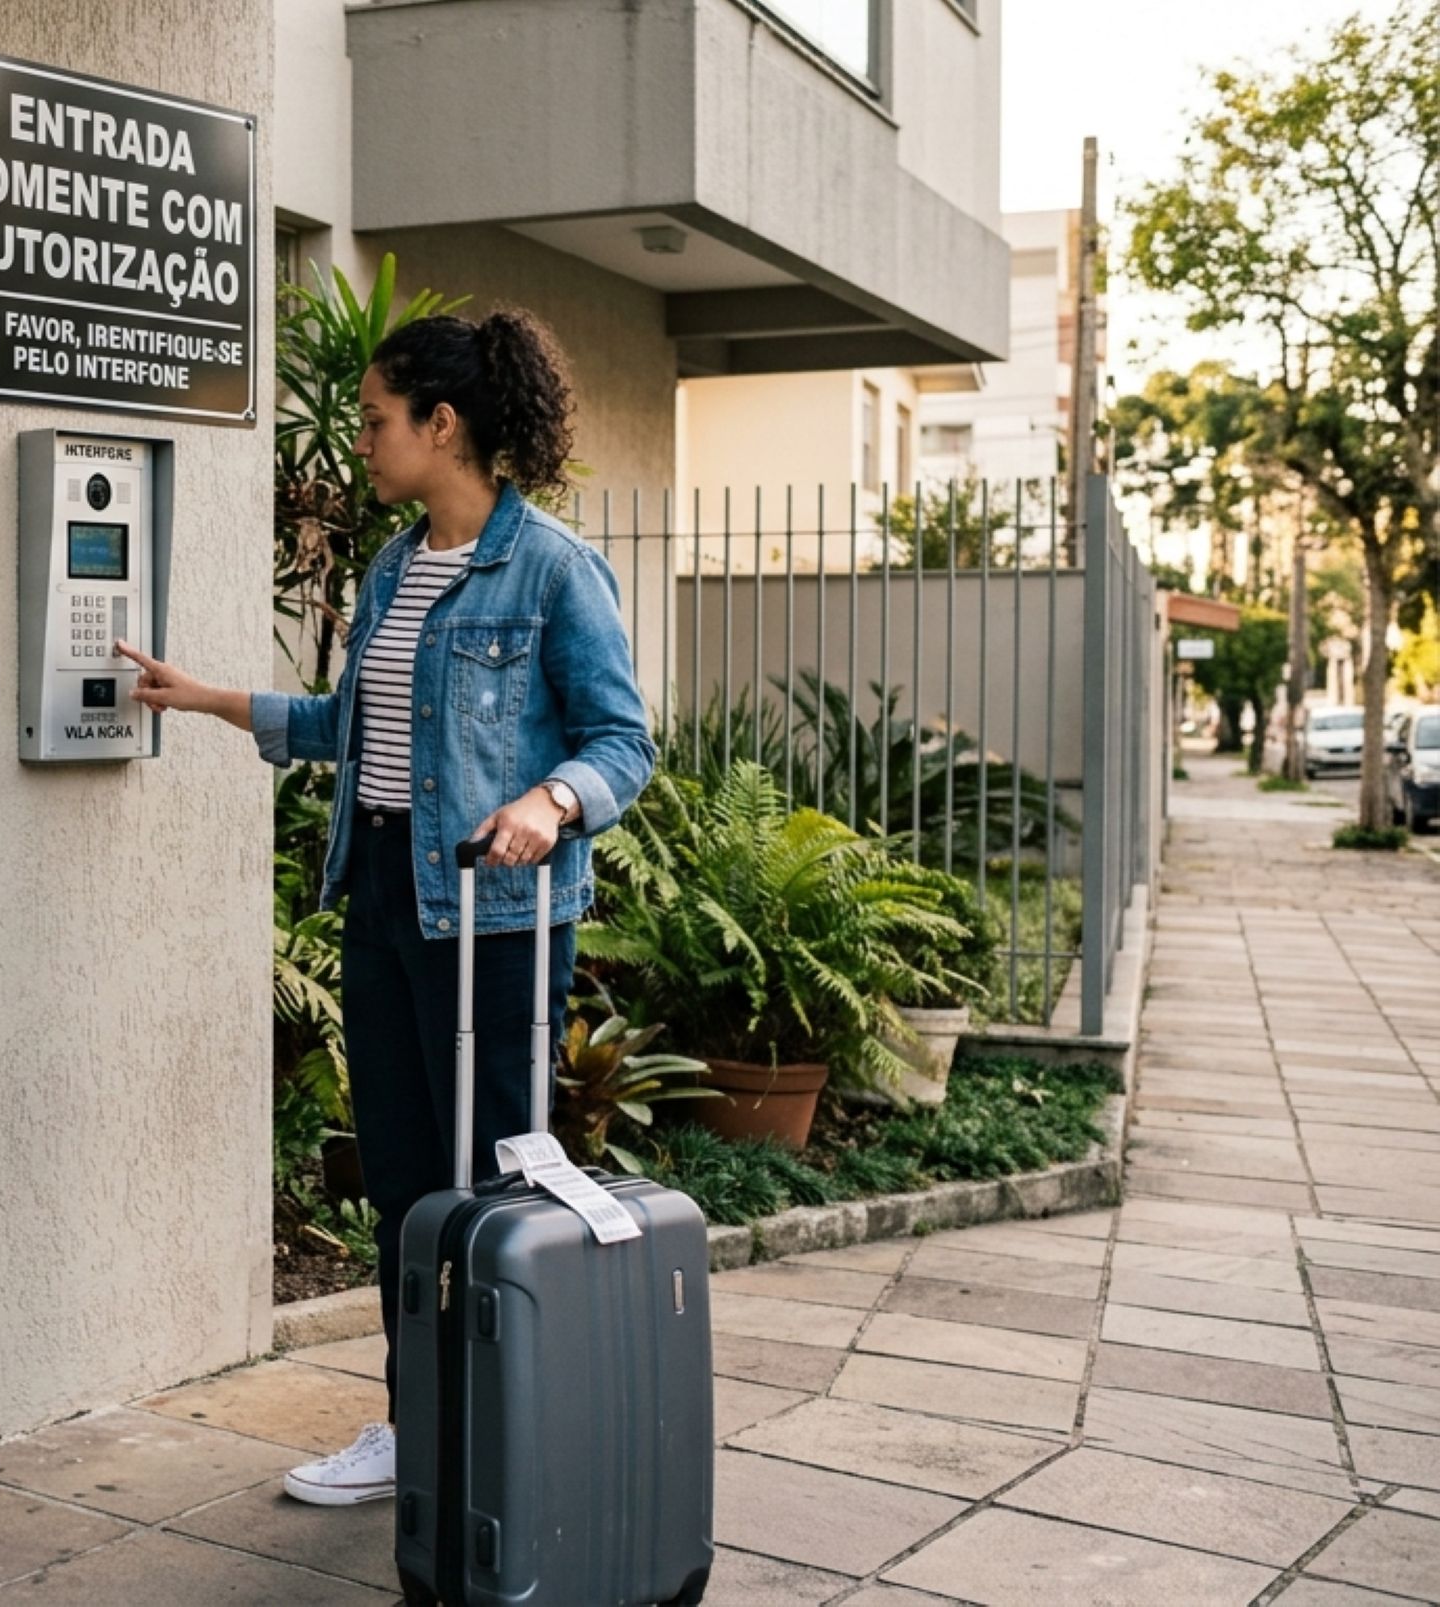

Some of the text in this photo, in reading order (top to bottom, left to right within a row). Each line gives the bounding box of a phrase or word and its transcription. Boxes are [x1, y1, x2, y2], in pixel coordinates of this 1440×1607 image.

[10, 92, 196, 176] ENTRADA
[161, 189, 243, 246] COM
[5, 311, 82, 350] FAVOR,
[13, 345, 190, 390] PELO INTERFONE
